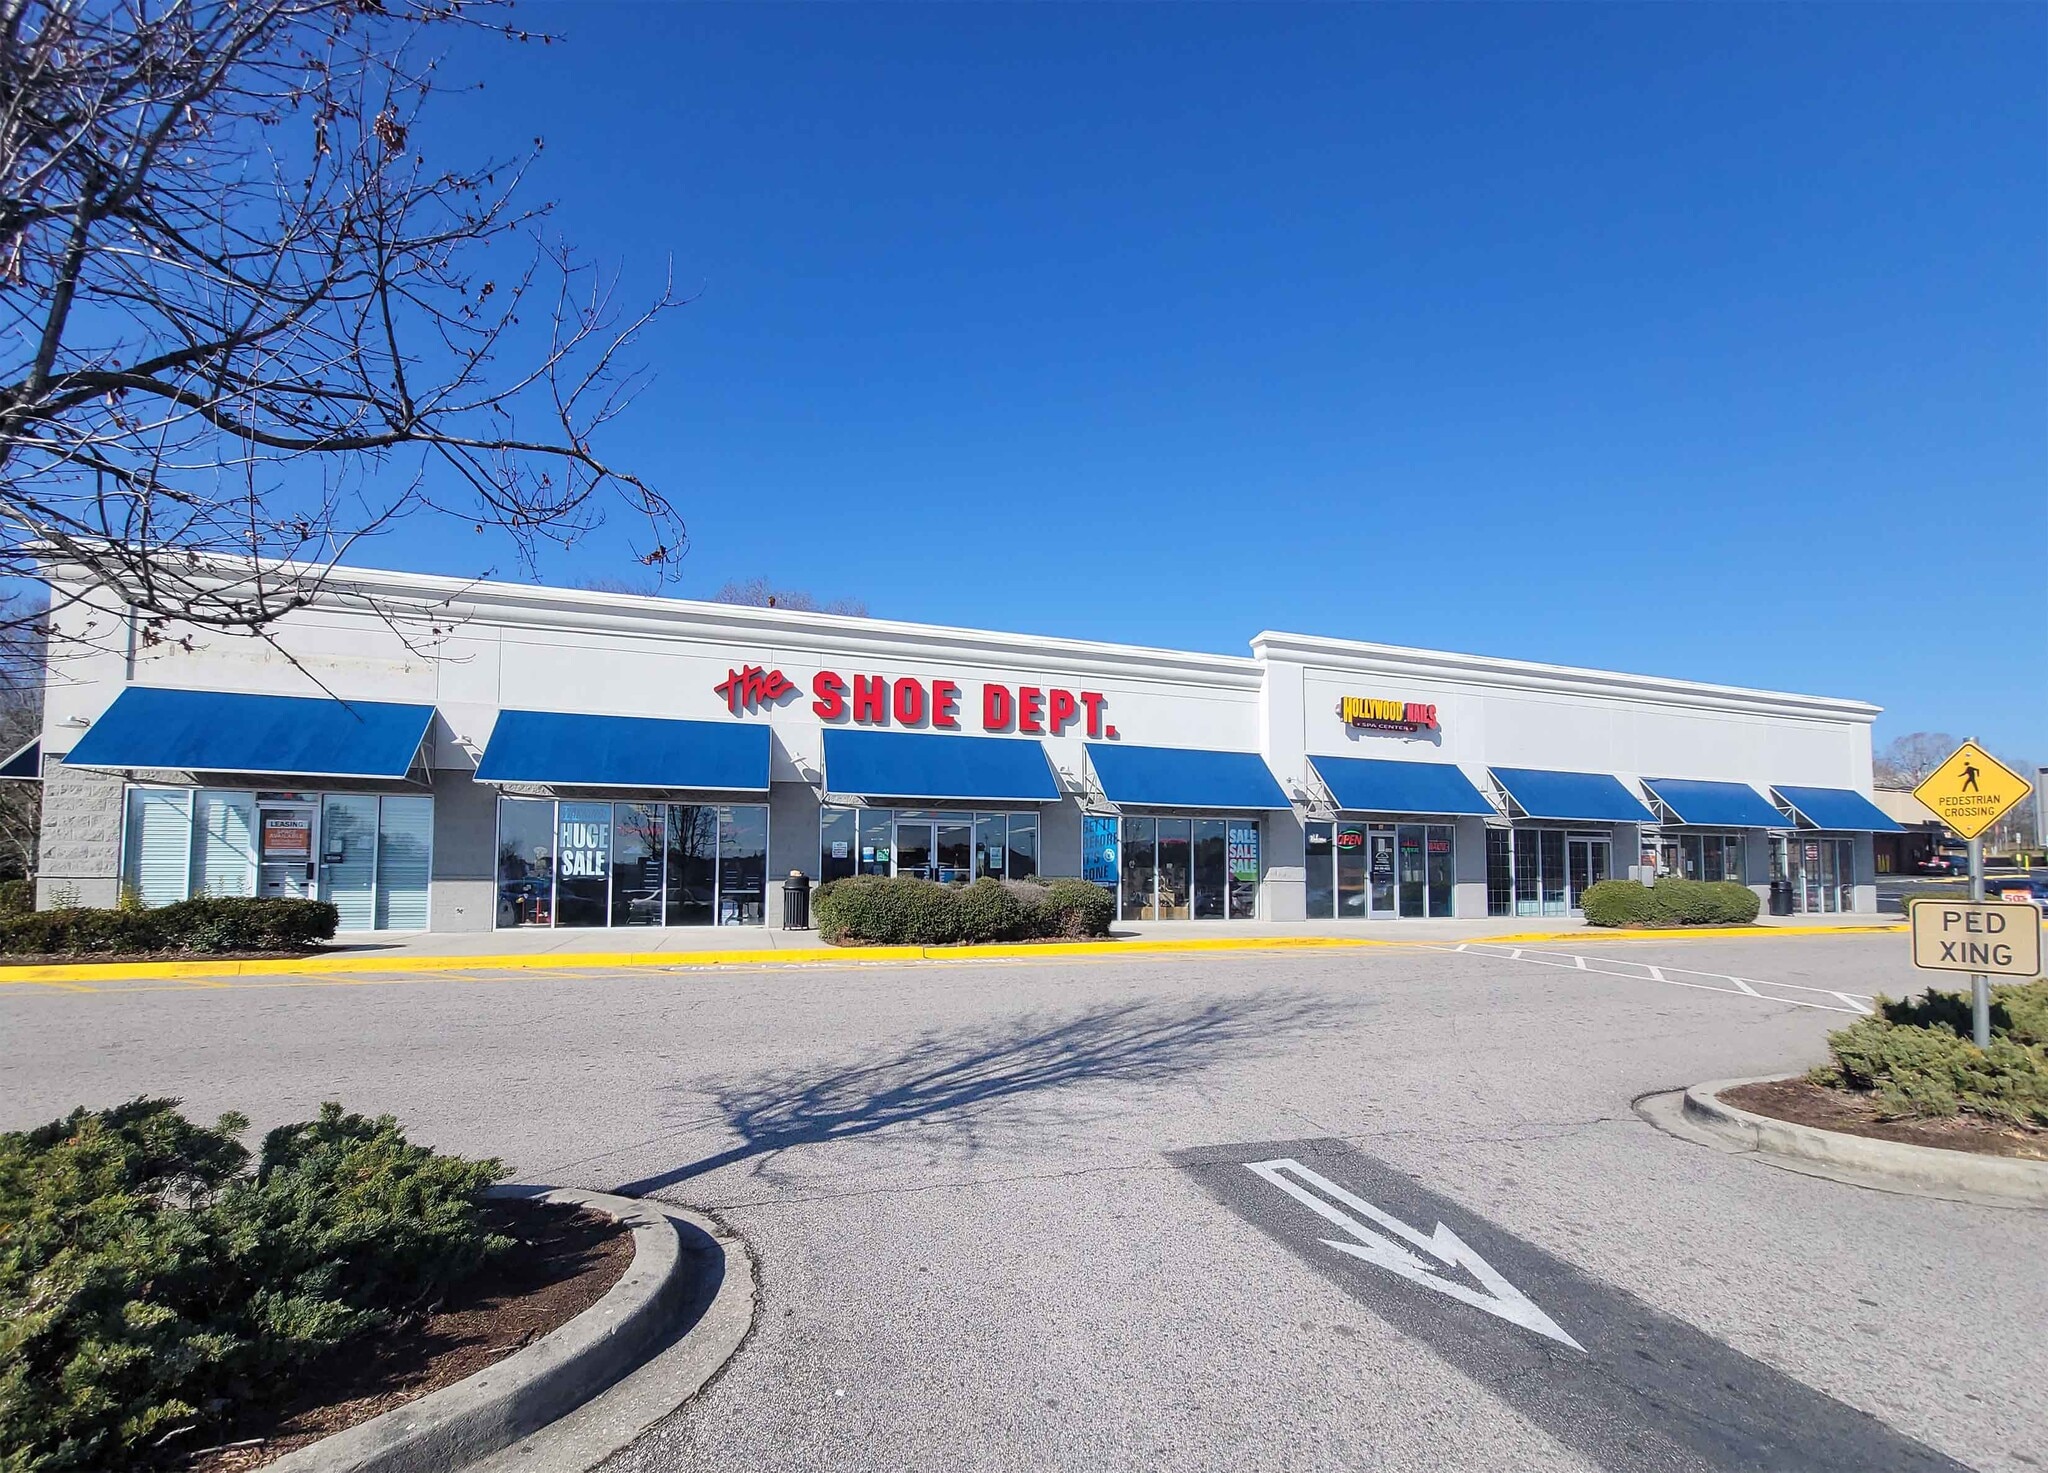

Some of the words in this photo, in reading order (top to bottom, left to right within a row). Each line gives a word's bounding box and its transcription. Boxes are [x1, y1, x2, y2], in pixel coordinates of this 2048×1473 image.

[714, 664, 794, 713] the
[812, 671, 956, 727] SHOE
[983, 683, 1117, 737] DEPT.
[1342, 696, 1404, 723] HOLLYWOOD
[1406, 702, 1438, 730] NAILS
[1378, 723, 1409, 731] CENTER
[1939, 795, 2001, 806] PEDESTRIAN
[1944, 807, 1995, 817] CROSSING
[560, 823, 609, 848] HUGE
[1229, 829, 1257, 843] SALE
[1337, 834, 1362, 846] OPEN
[1229, 844, 1257, 858] SALE
[562, 850, 606, 875] SALE
[1229, 859, 1257, 873] SALE
[1943, 911, 2006, 933] PED
[1940, 941, 2013, 966] XING
